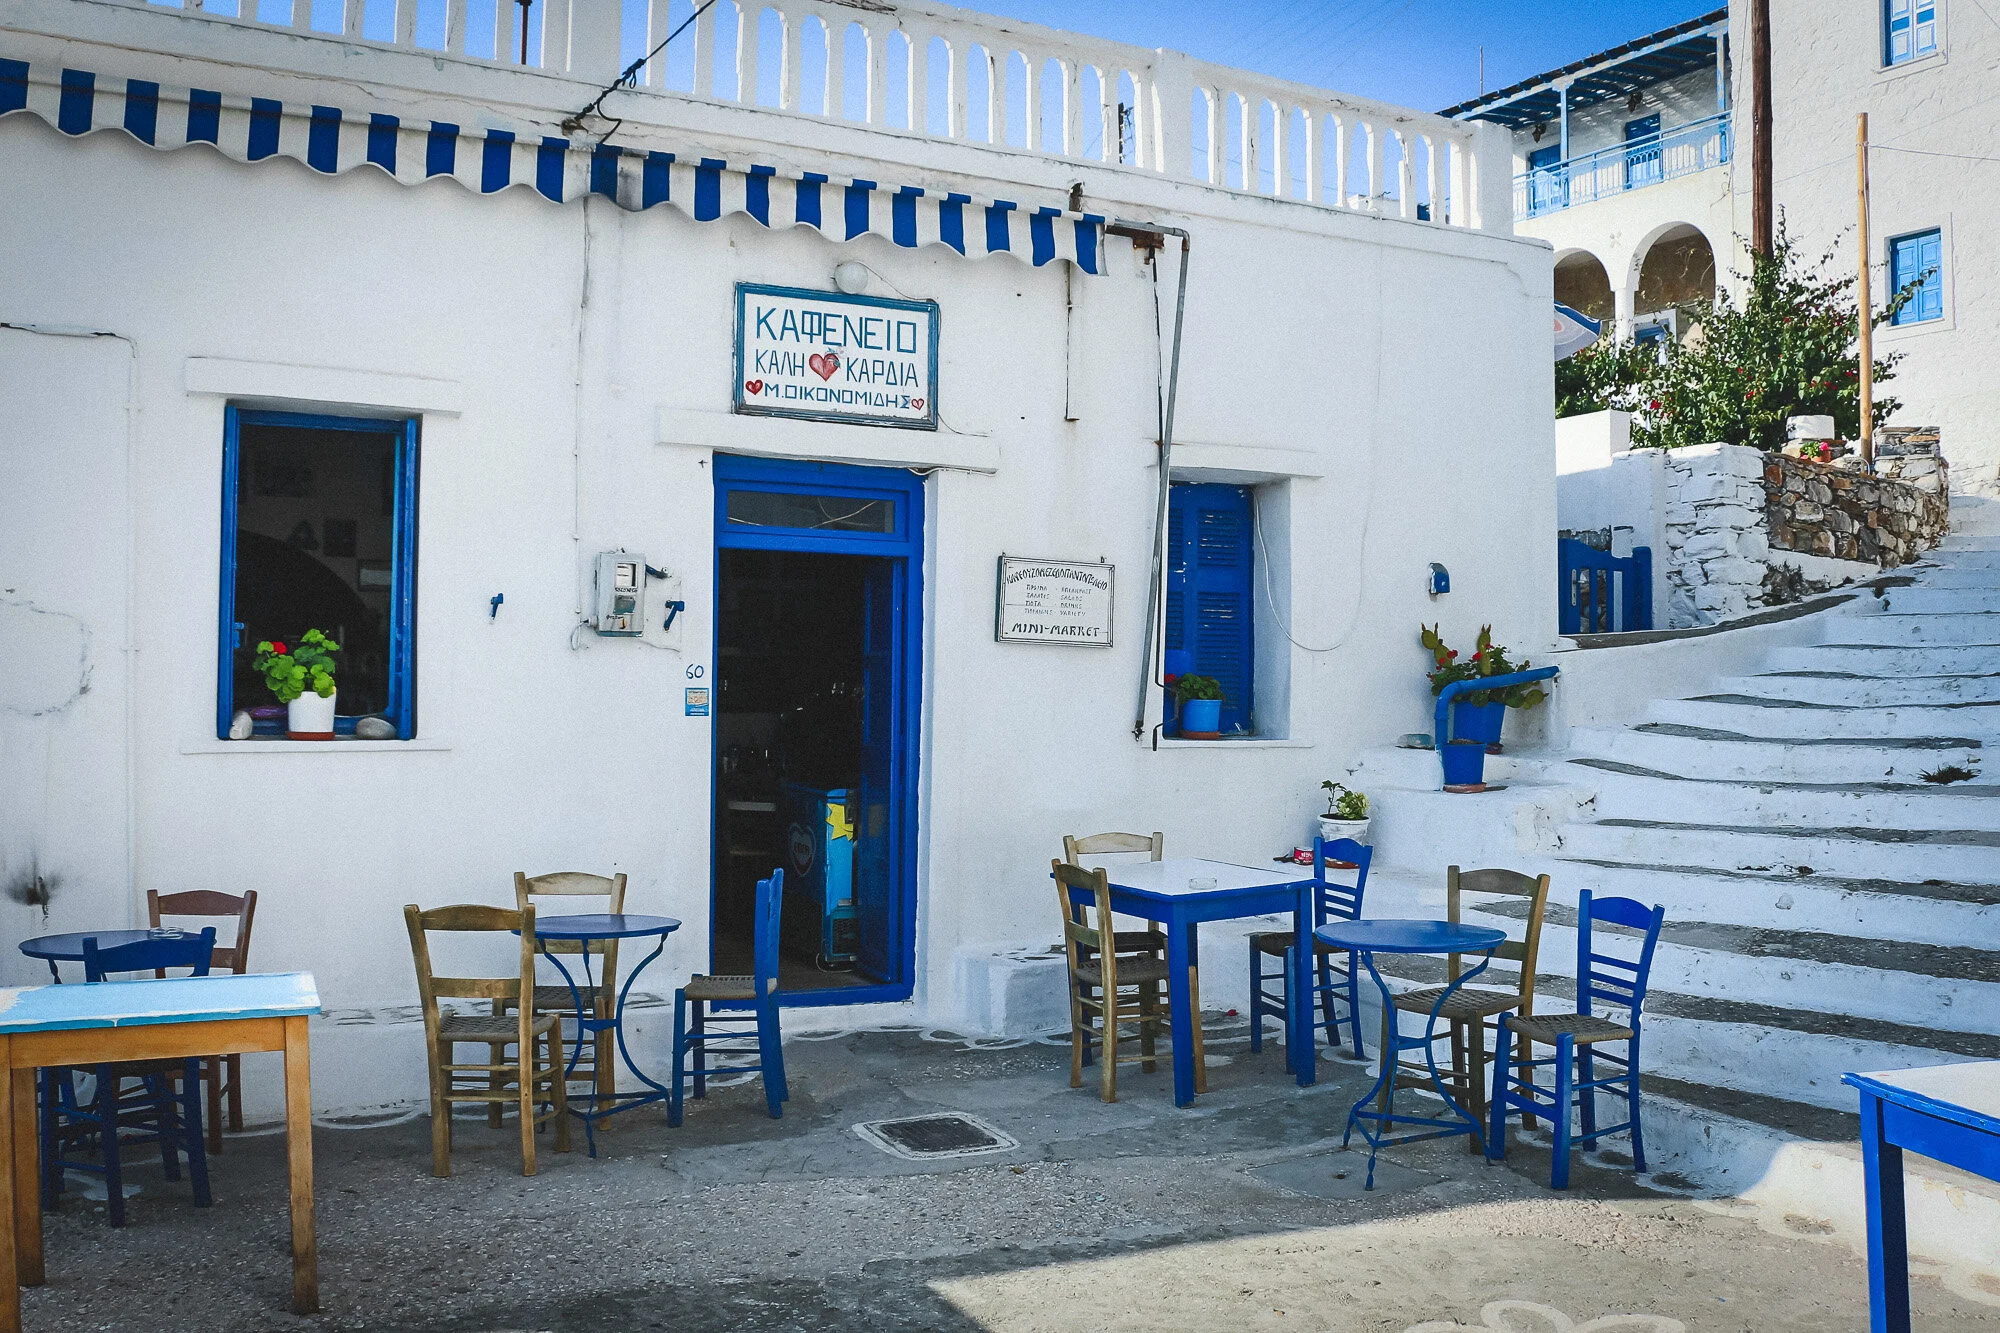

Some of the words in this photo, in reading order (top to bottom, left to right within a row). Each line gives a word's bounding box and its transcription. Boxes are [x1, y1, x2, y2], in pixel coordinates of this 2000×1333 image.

[756, 306, 917, 354] ΚΑΦΕΝΕΙΟ
[755, 348, 805, 377] ΚΑΛΗ
[846, 356, 919, 388] ΚΑΡΔΙΑ
[1012, 622, 1100, 637] MINI-MARKET
[686, 664, 705, 680] 60
